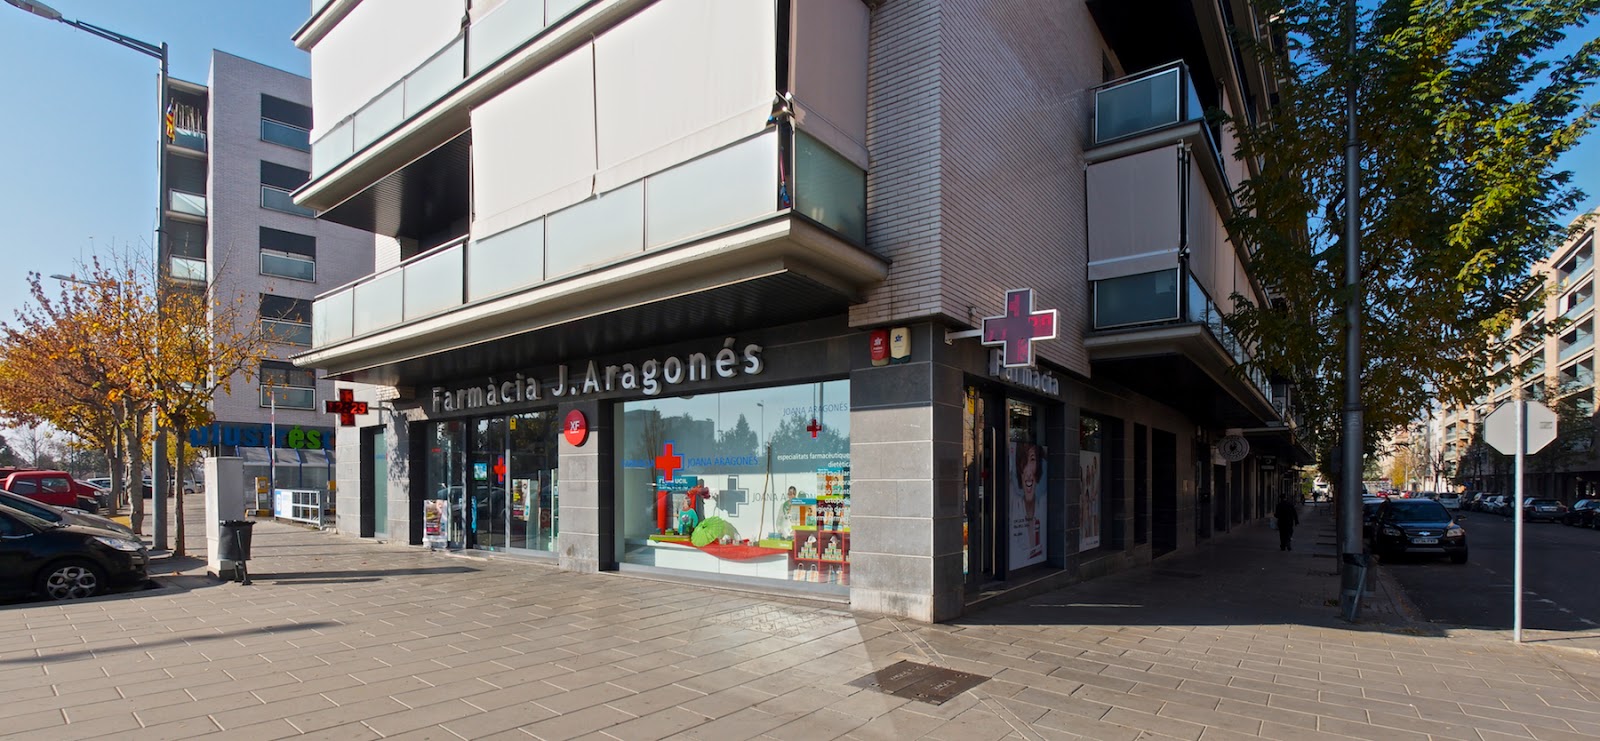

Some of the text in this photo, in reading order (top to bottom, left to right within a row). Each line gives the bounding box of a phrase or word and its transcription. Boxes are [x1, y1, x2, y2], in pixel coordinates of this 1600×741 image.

[431, 373, 542, 413] Farmàcia
[783, 402, 848, 417] JOANA ARAGONÉS
[687, 458, 713, 468] JOANA
[714, 455, 759, 466] ARAGONÉS
